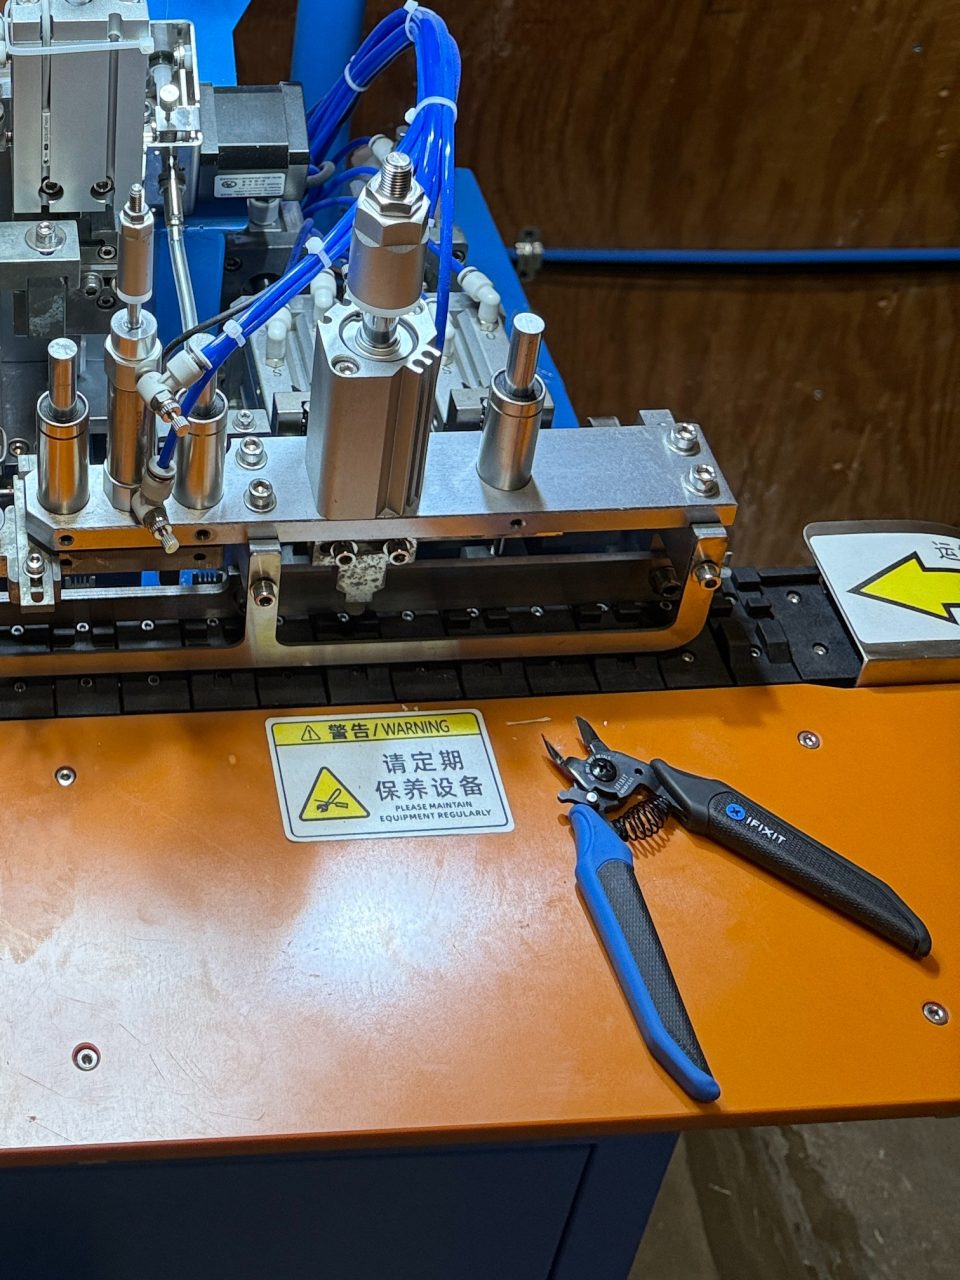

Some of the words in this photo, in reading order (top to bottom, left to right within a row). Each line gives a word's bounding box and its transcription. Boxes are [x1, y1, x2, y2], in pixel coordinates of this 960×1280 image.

[931, 540, 960, 561] 运
[382, 750, 465, 775] 请定期
[375, 775, 483, 801] 保养设备
[380, 811, 435, 823] EQUIPMENT
[438, 808, 492, 820] REGULARLY
[395, 802, 428, 812] PLEASE
[429, 800, 473, 810] MAINTAIN
[746, 816, 787, 844] IFIXIT
